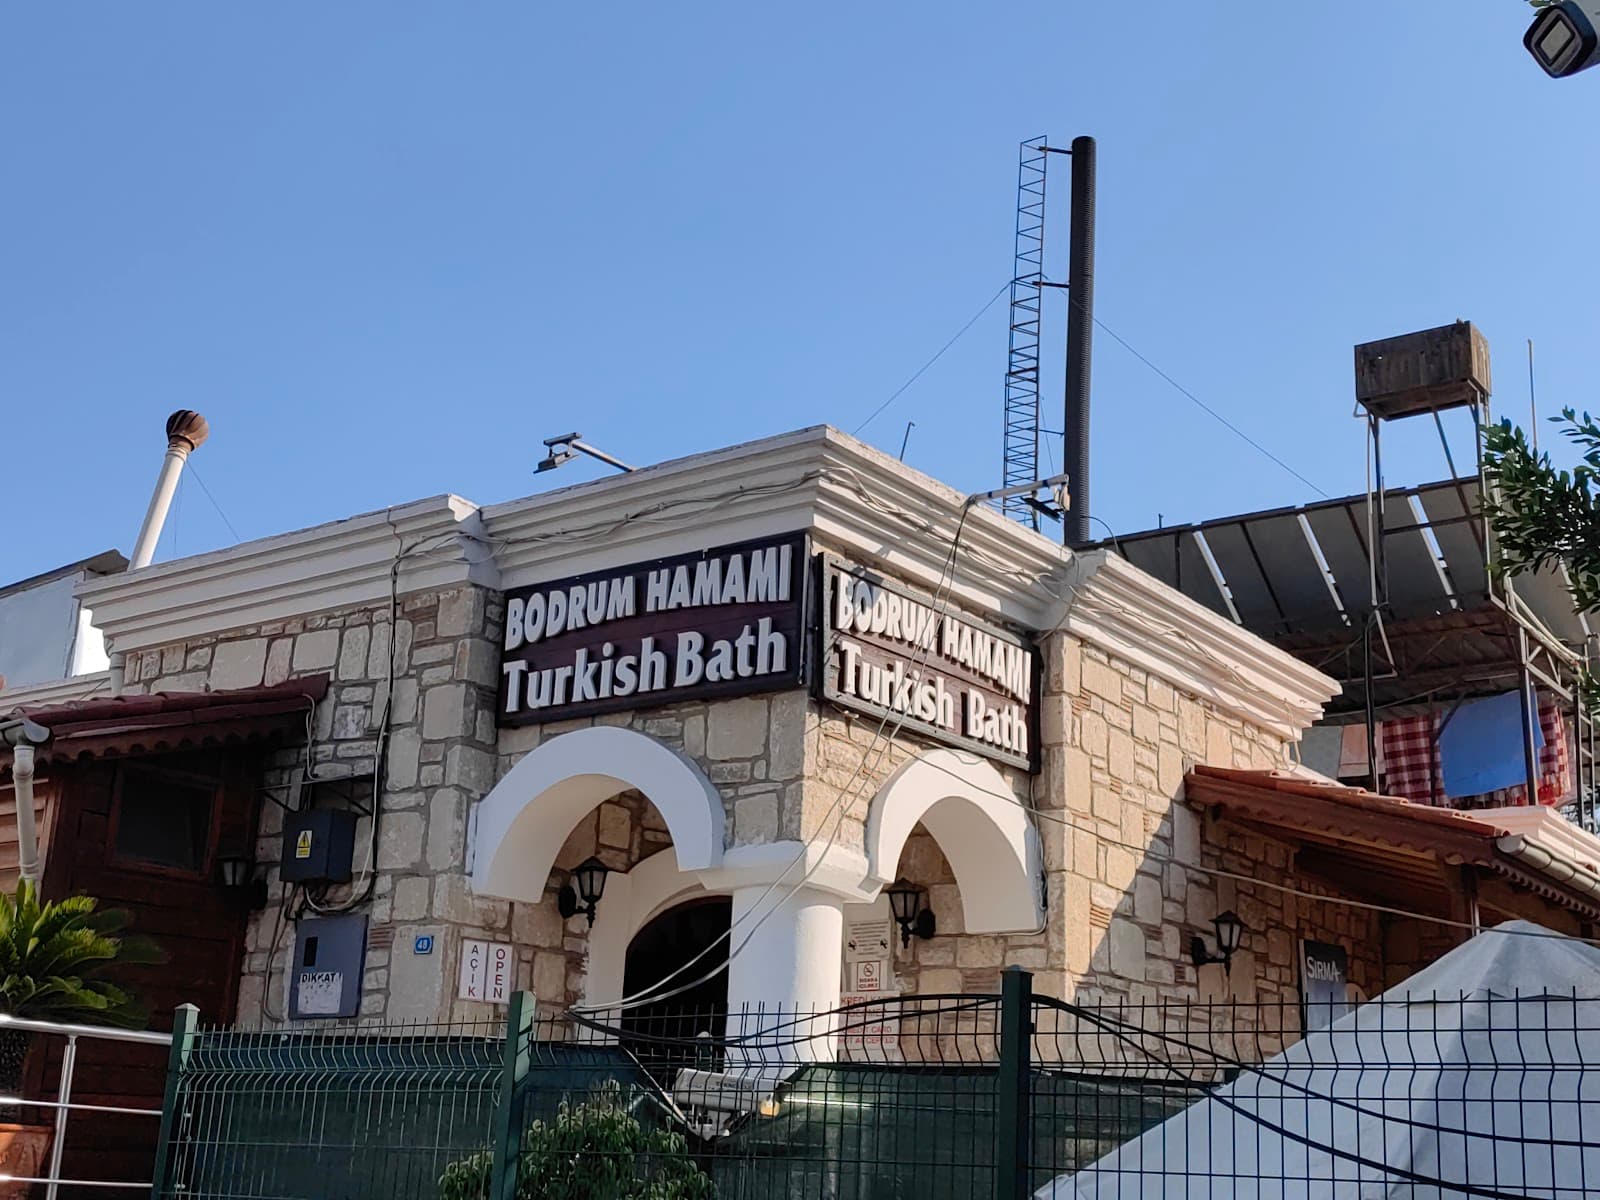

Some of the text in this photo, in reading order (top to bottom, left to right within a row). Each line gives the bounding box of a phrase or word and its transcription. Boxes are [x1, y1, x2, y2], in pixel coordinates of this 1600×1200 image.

[505, 544, 792, 651] BODRUM HAMAMI
[836, 571, 1032, 705] BODRUM HAMAMI
[503, 616, 787, 713] Turkish Bath
[840, 640, 1029, 754] Turkish Bath
[468, 944, 479, 997] AÇIK
[493, 948, 506, 999] OPEN
